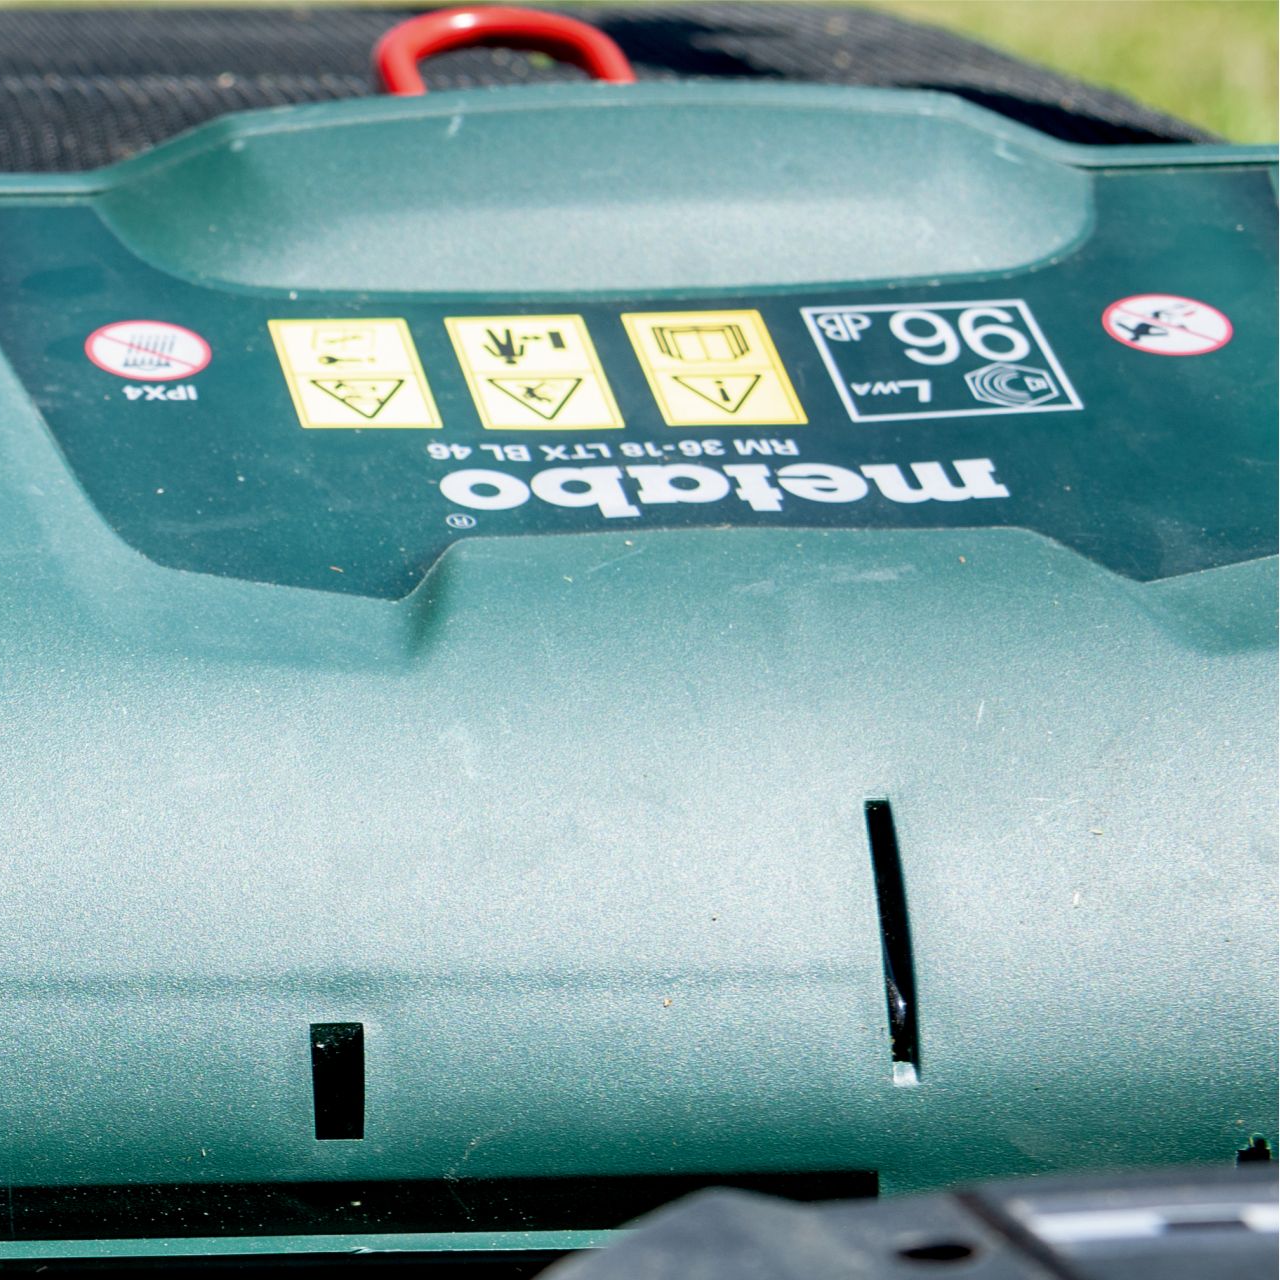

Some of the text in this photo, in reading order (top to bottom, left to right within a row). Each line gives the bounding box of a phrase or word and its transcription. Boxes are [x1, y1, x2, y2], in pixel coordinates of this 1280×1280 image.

[816, 306, 1031, 367] 96 dB
[121, 384, 198, 402] IPX4
[426, 438, 800, 463] RM 36-18 LTX BL 46
[439, 457, 1011, 519] metabo
